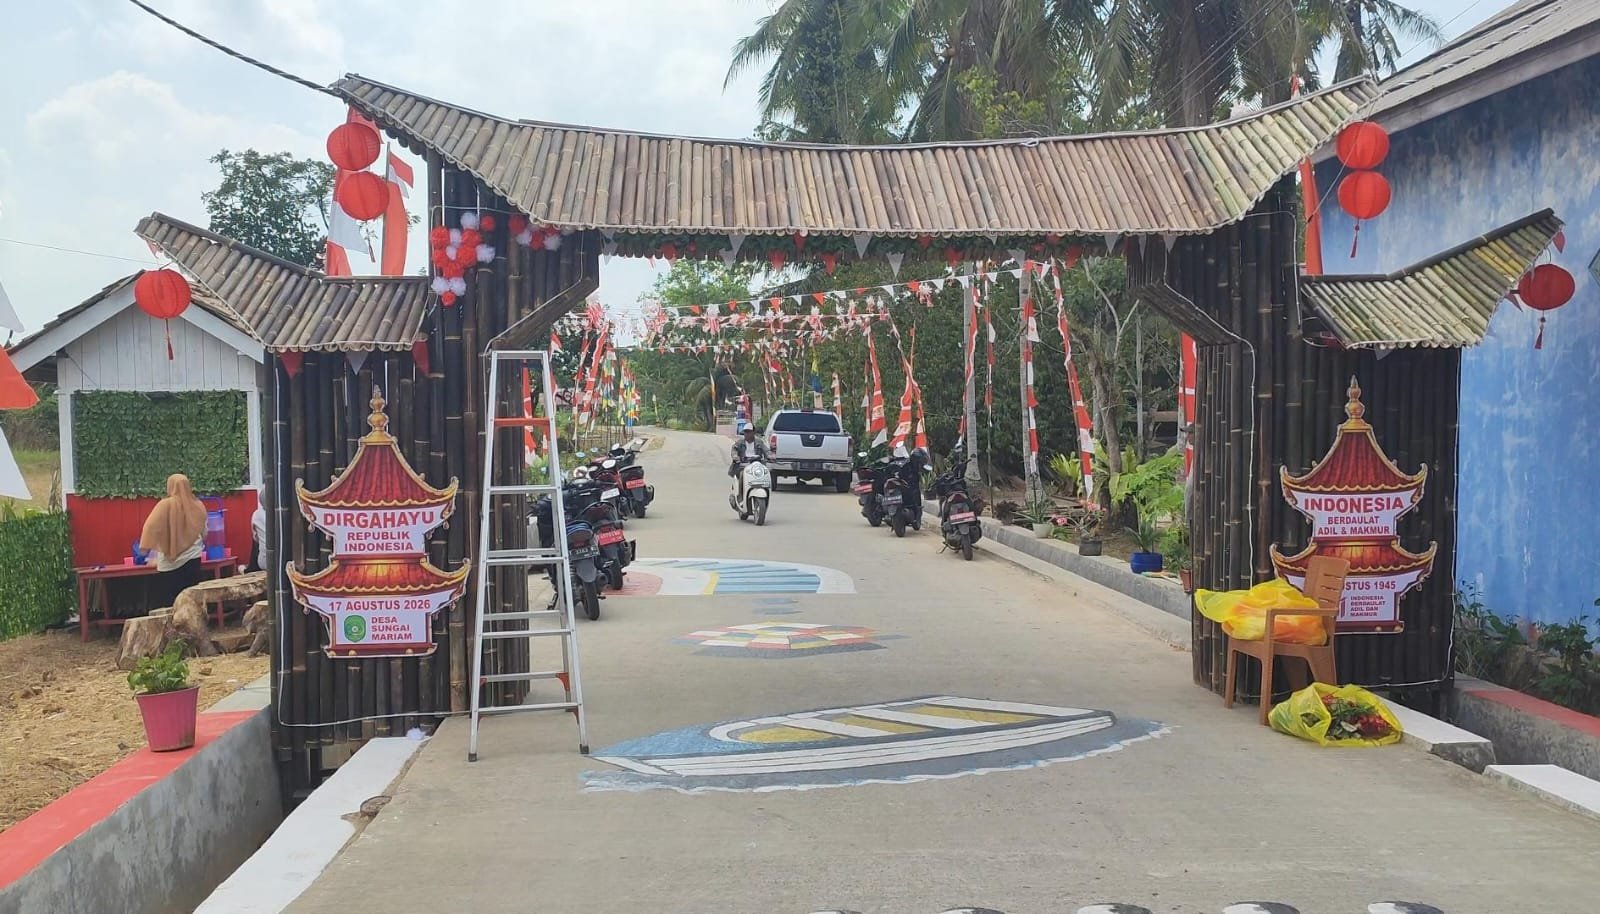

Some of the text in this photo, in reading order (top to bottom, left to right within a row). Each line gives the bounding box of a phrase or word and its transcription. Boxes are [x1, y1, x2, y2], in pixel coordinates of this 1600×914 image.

[1304, 497, 1404, 513] INDONESIA
[323, 511, 434, 529] DIRGAHAYU
[1327, 515, 1380, 525] BERDAULAT
[1317, 525, 1390, 535] ADIL & MAKMUR
[347, 531, 410, 541] REPUBLIK
[344, 542, 413, 552] INDONESIA
[1374, 580, 1396, 590] 1945
[329, 599, 431, 612] 17 AGUSTUS 2026
[371, 616, 398, 624] DESA
[371, 624, 410, 633] SUNGAI
[371, 633, 413, 641] MARIAM
